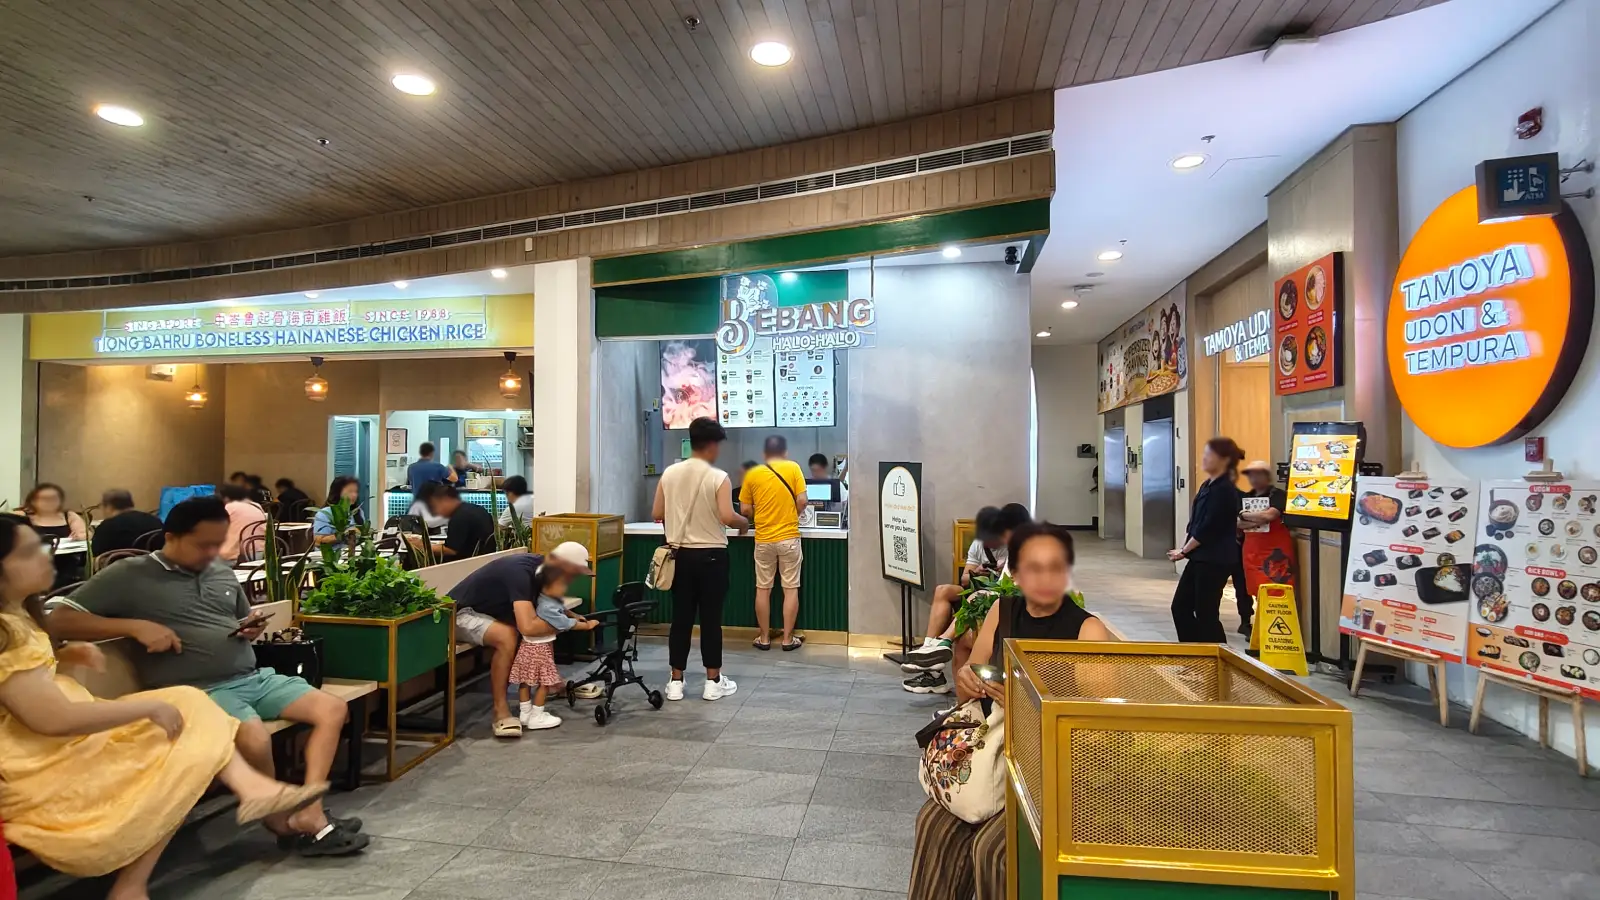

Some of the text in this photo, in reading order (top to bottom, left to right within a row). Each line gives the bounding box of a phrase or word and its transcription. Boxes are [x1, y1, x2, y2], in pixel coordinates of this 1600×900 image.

[1524, 190, 1544, 200] ATM
[1401, 246, 1527, 309] TAMOYA
[124, 318, 203, 333] SINGAPORE
[365, 308, 449, 323] SINCE 1988
[715, 298, 875, 355] BEBANG
[1405, 301, 1503, 343] UDON &
[94, 321, 488, 352] TIONG BAHRU BONELESS HAINANESE CHICKEN RICE
[772, 331, 860, 350] HALO-HALO
[1203, 320, 1247, 357] TAMOYA
[1234, 344, 1243, 363] &
[1405, 332, 1522, 374] TEMPURA
[1527, 567, 1541, 575] RICE
